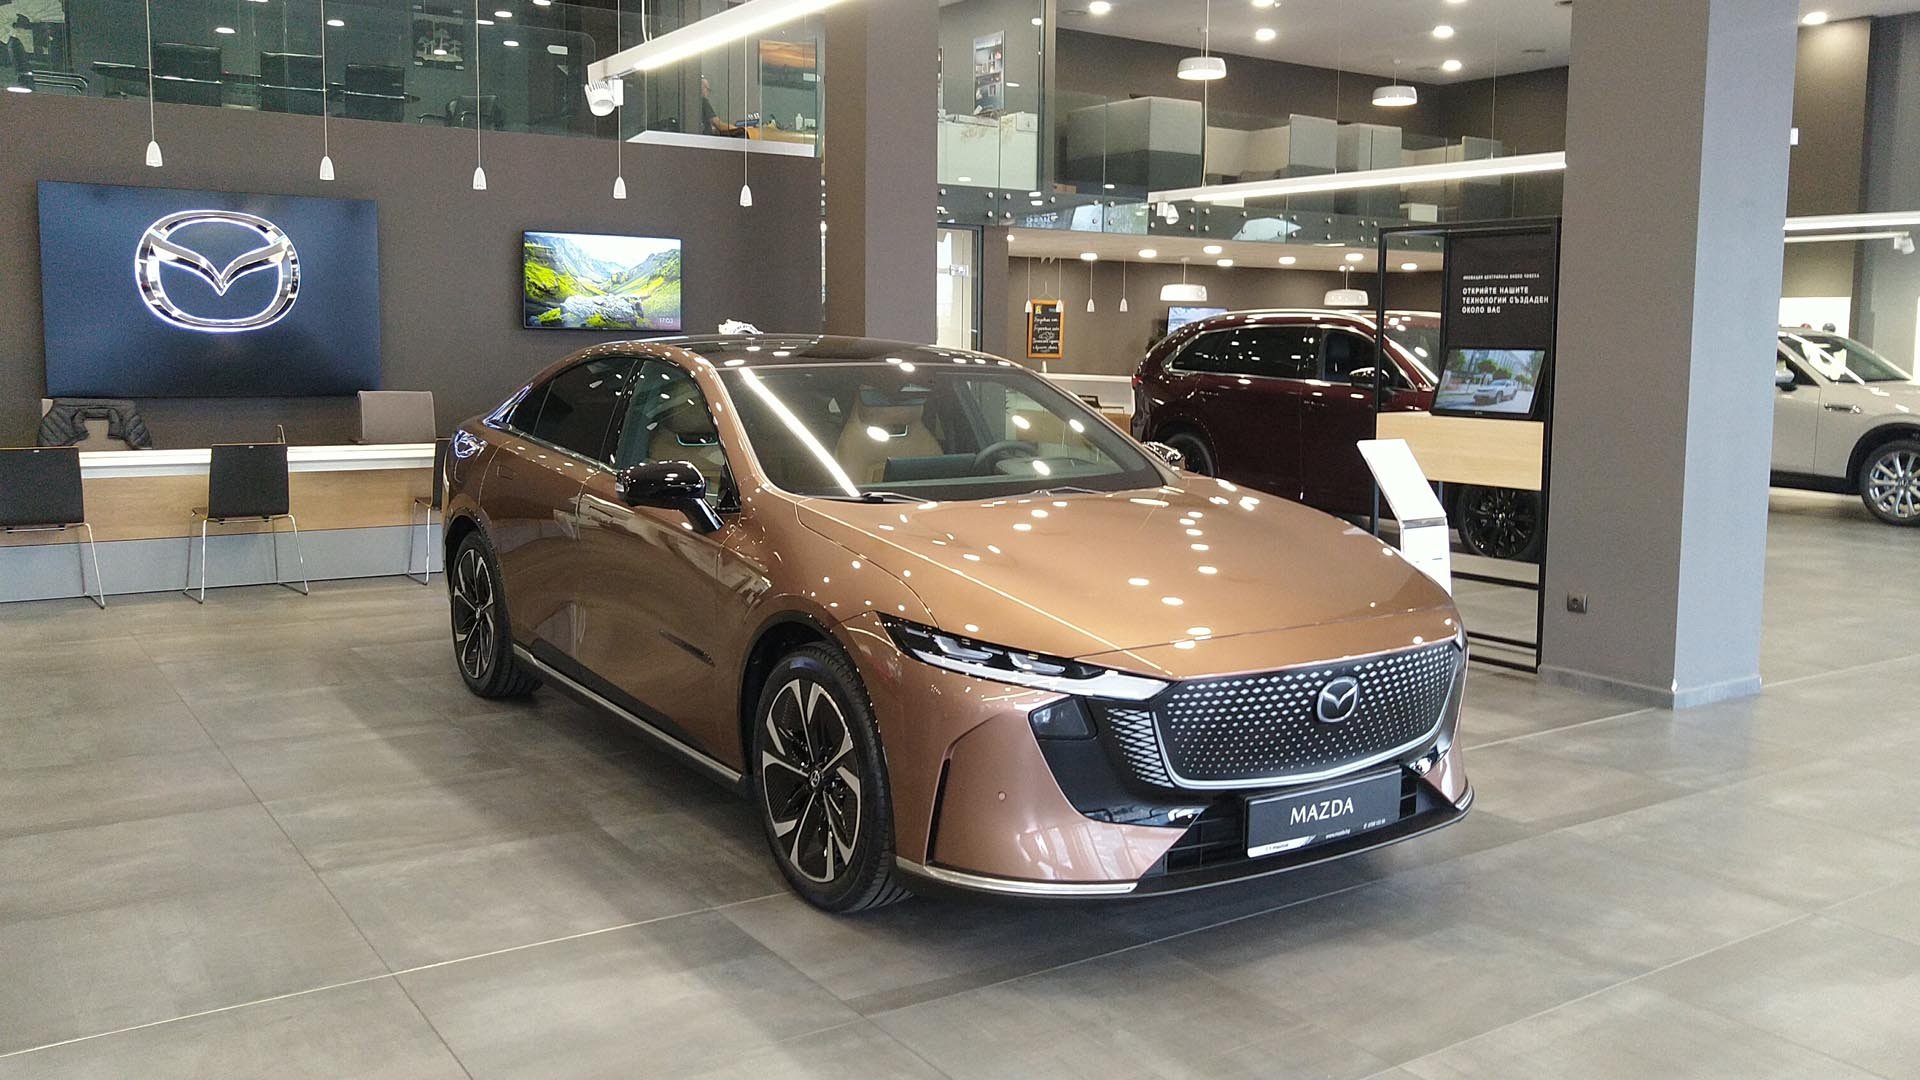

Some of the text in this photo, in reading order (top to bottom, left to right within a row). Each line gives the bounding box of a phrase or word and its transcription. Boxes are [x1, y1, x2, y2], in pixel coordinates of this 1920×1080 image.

[1462, 286, 1529, 294] ОТКРИЙТЕ НАШИТЕ
[1462, 296, 1507, 304] ТЕХНОЛОГИИ
[1290, 797, 1354, 825] MAZDA
